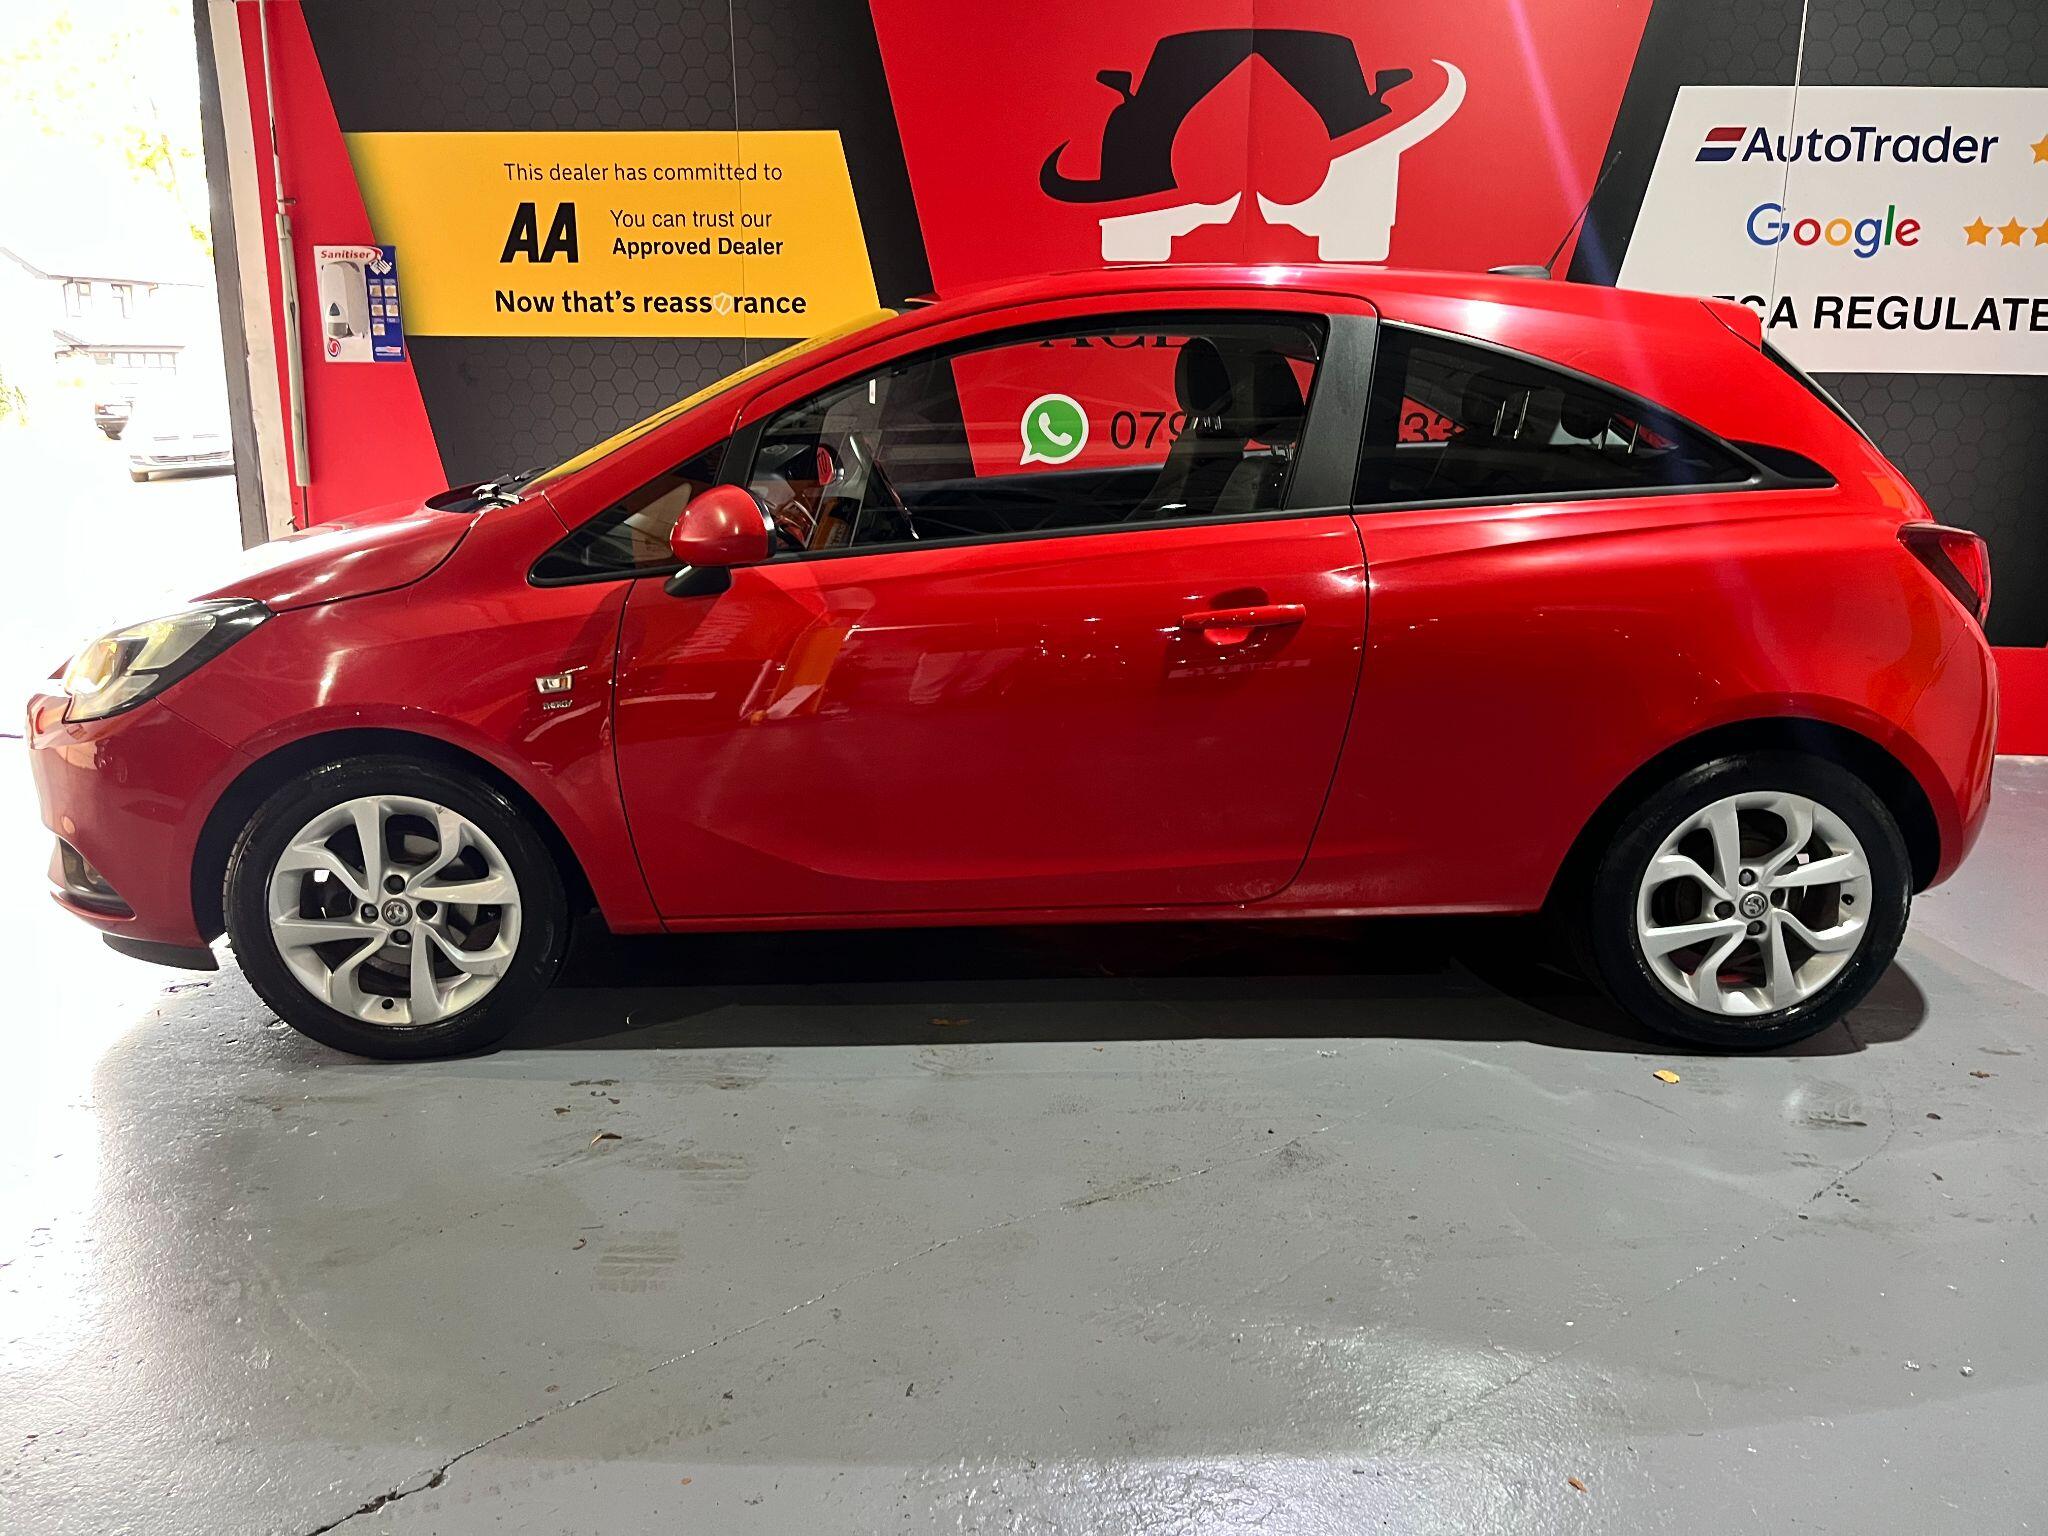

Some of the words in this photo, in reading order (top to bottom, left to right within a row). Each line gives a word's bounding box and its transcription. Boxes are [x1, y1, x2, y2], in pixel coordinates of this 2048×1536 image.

[1742, 126, 1999, 164] AutoTrader
[503, 163, 543, 181] This
[549, 163, 608, 181] dealer
[614, 163, 648, 181] has
[653, 163, 757, 181] committed
[764, 164, 783, 181] to
[610, 209, 645, 228] You
[652, 213, 686, 228] can
[692, 211, 735, 228] trust
[741, 213, 773, 228] our
[500, 202, 579, 263] AA
[1746, 202, 1921, 259] Google
[320, 250, 371, 259] Sanitiser
[612, 237, 711, 260] Approved
[718, 237, 784, 255] Dealer
[495, 290, 554, 313] Now
[561, 290, 636, 313] that’s
